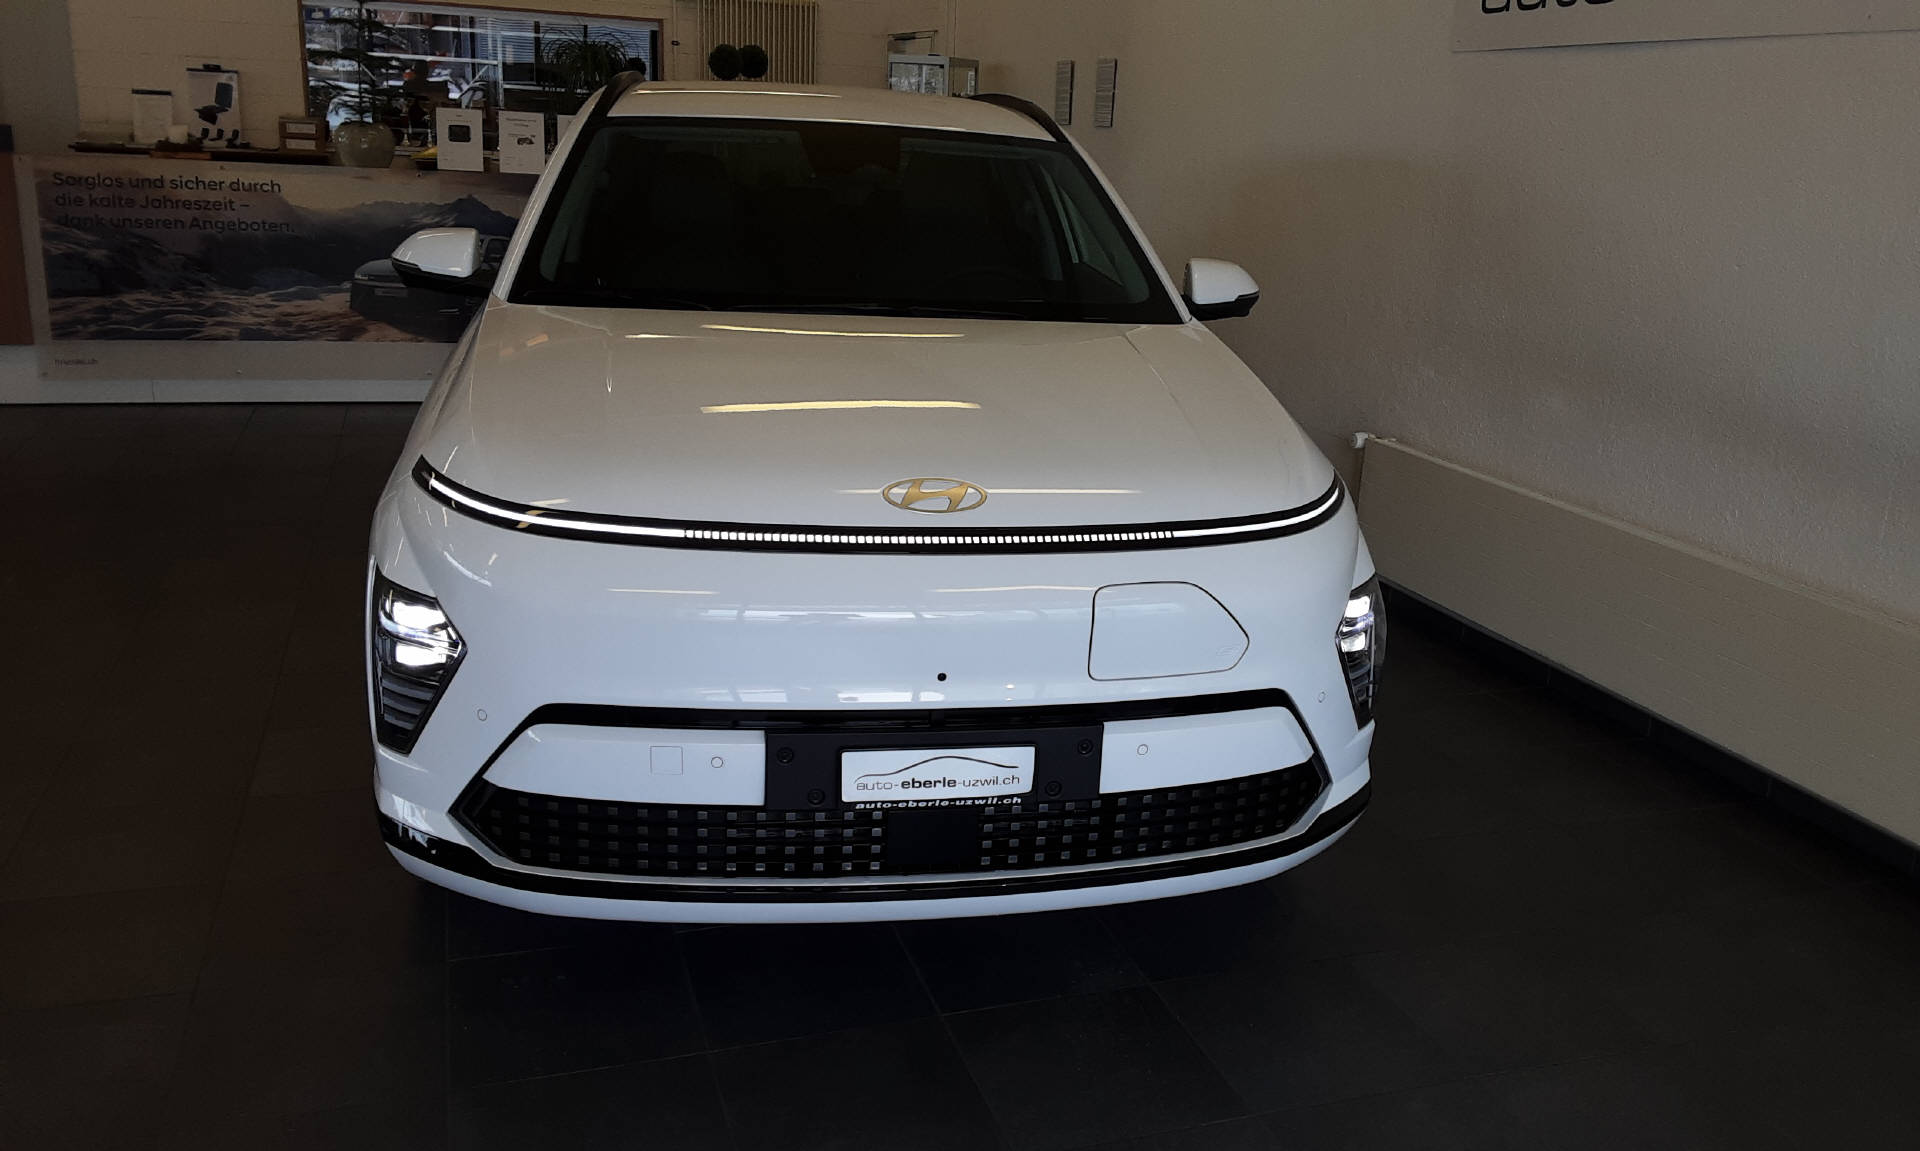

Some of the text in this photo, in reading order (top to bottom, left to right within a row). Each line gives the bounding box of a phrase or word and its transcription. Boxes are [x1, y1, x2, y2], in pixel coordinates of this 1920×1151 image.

[53, 172, 281, 193] Sorglos und sicher durch
[55, 194, 85, 207] die
[89, 194, 135, 208] kalte
[140, 195, 236, 211] Jahreszeit
[57, 213, 295, 233] dank unseren Angeboten.
[856, 775, 1020, 791] auto-eberle-uzwil.ch
[855, 797, 1022, 809] auto-eberle-uzwil.ch
